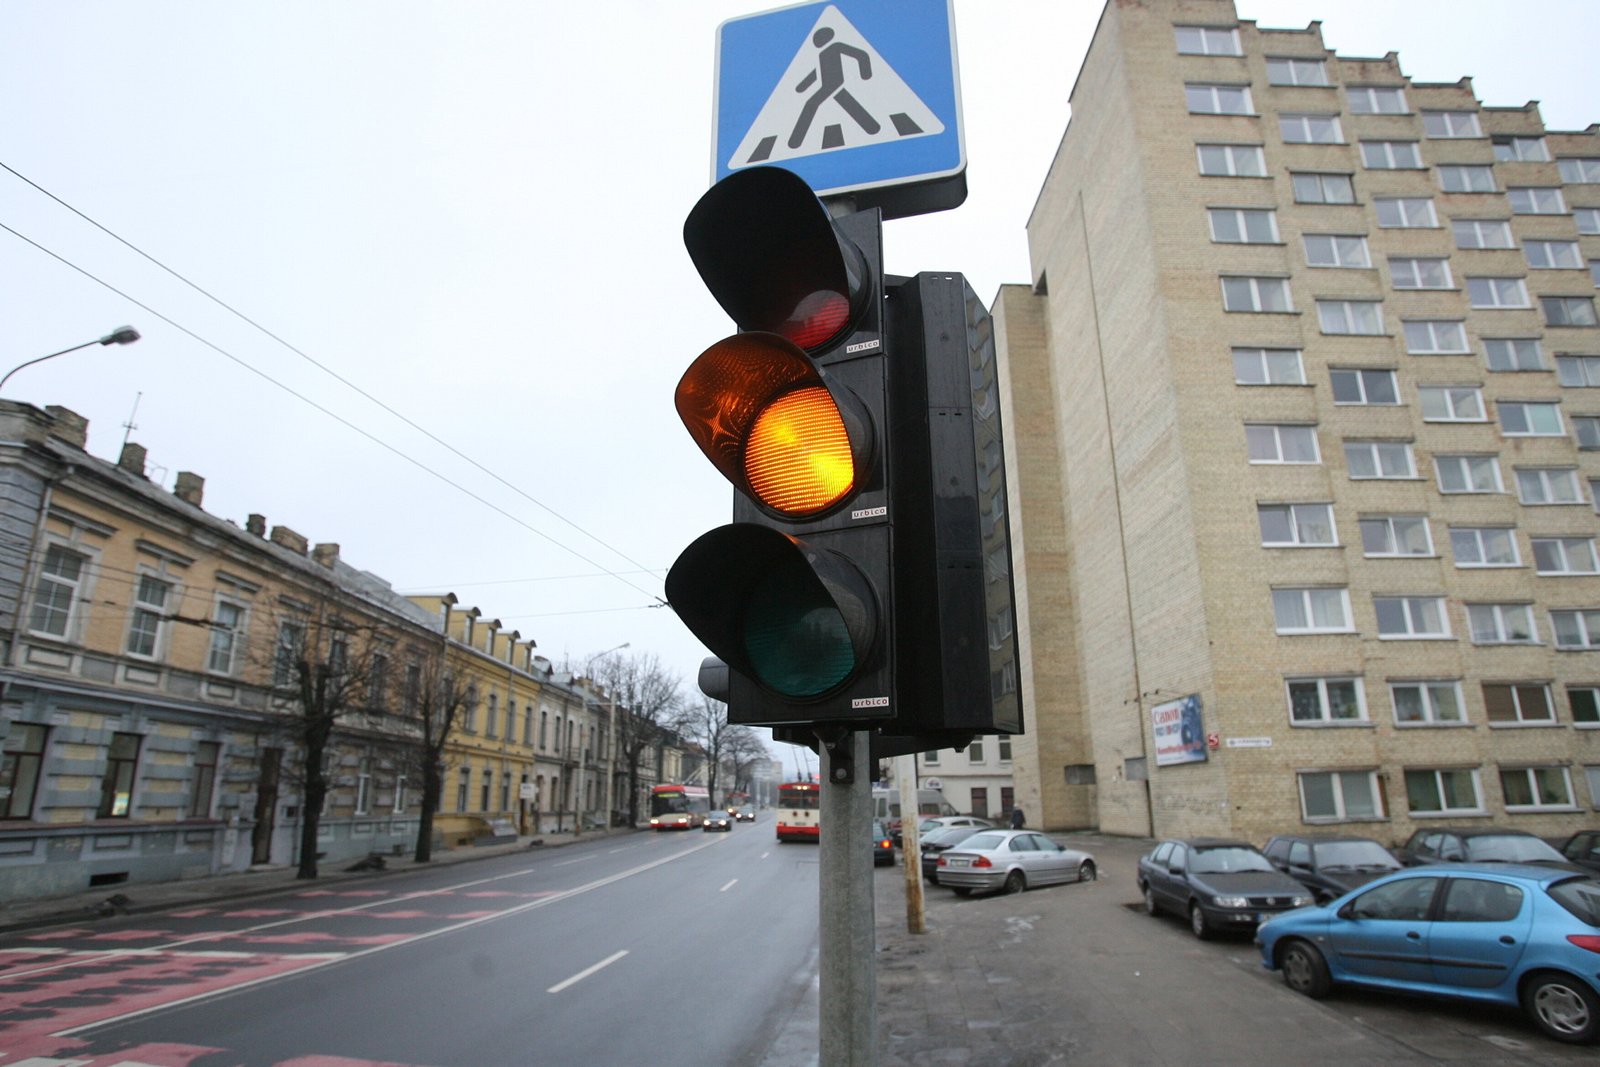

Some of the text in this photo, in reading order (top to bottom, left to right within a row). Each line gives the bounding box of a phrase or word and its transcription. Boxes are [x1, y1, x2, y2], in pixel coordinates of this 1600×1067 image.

[848, 341, 878, 352] urbico
[853, 508, 885, 518] urbico
[854, 698, 887, 707] urbico
[1153, 708, 1180, 725] Canon
